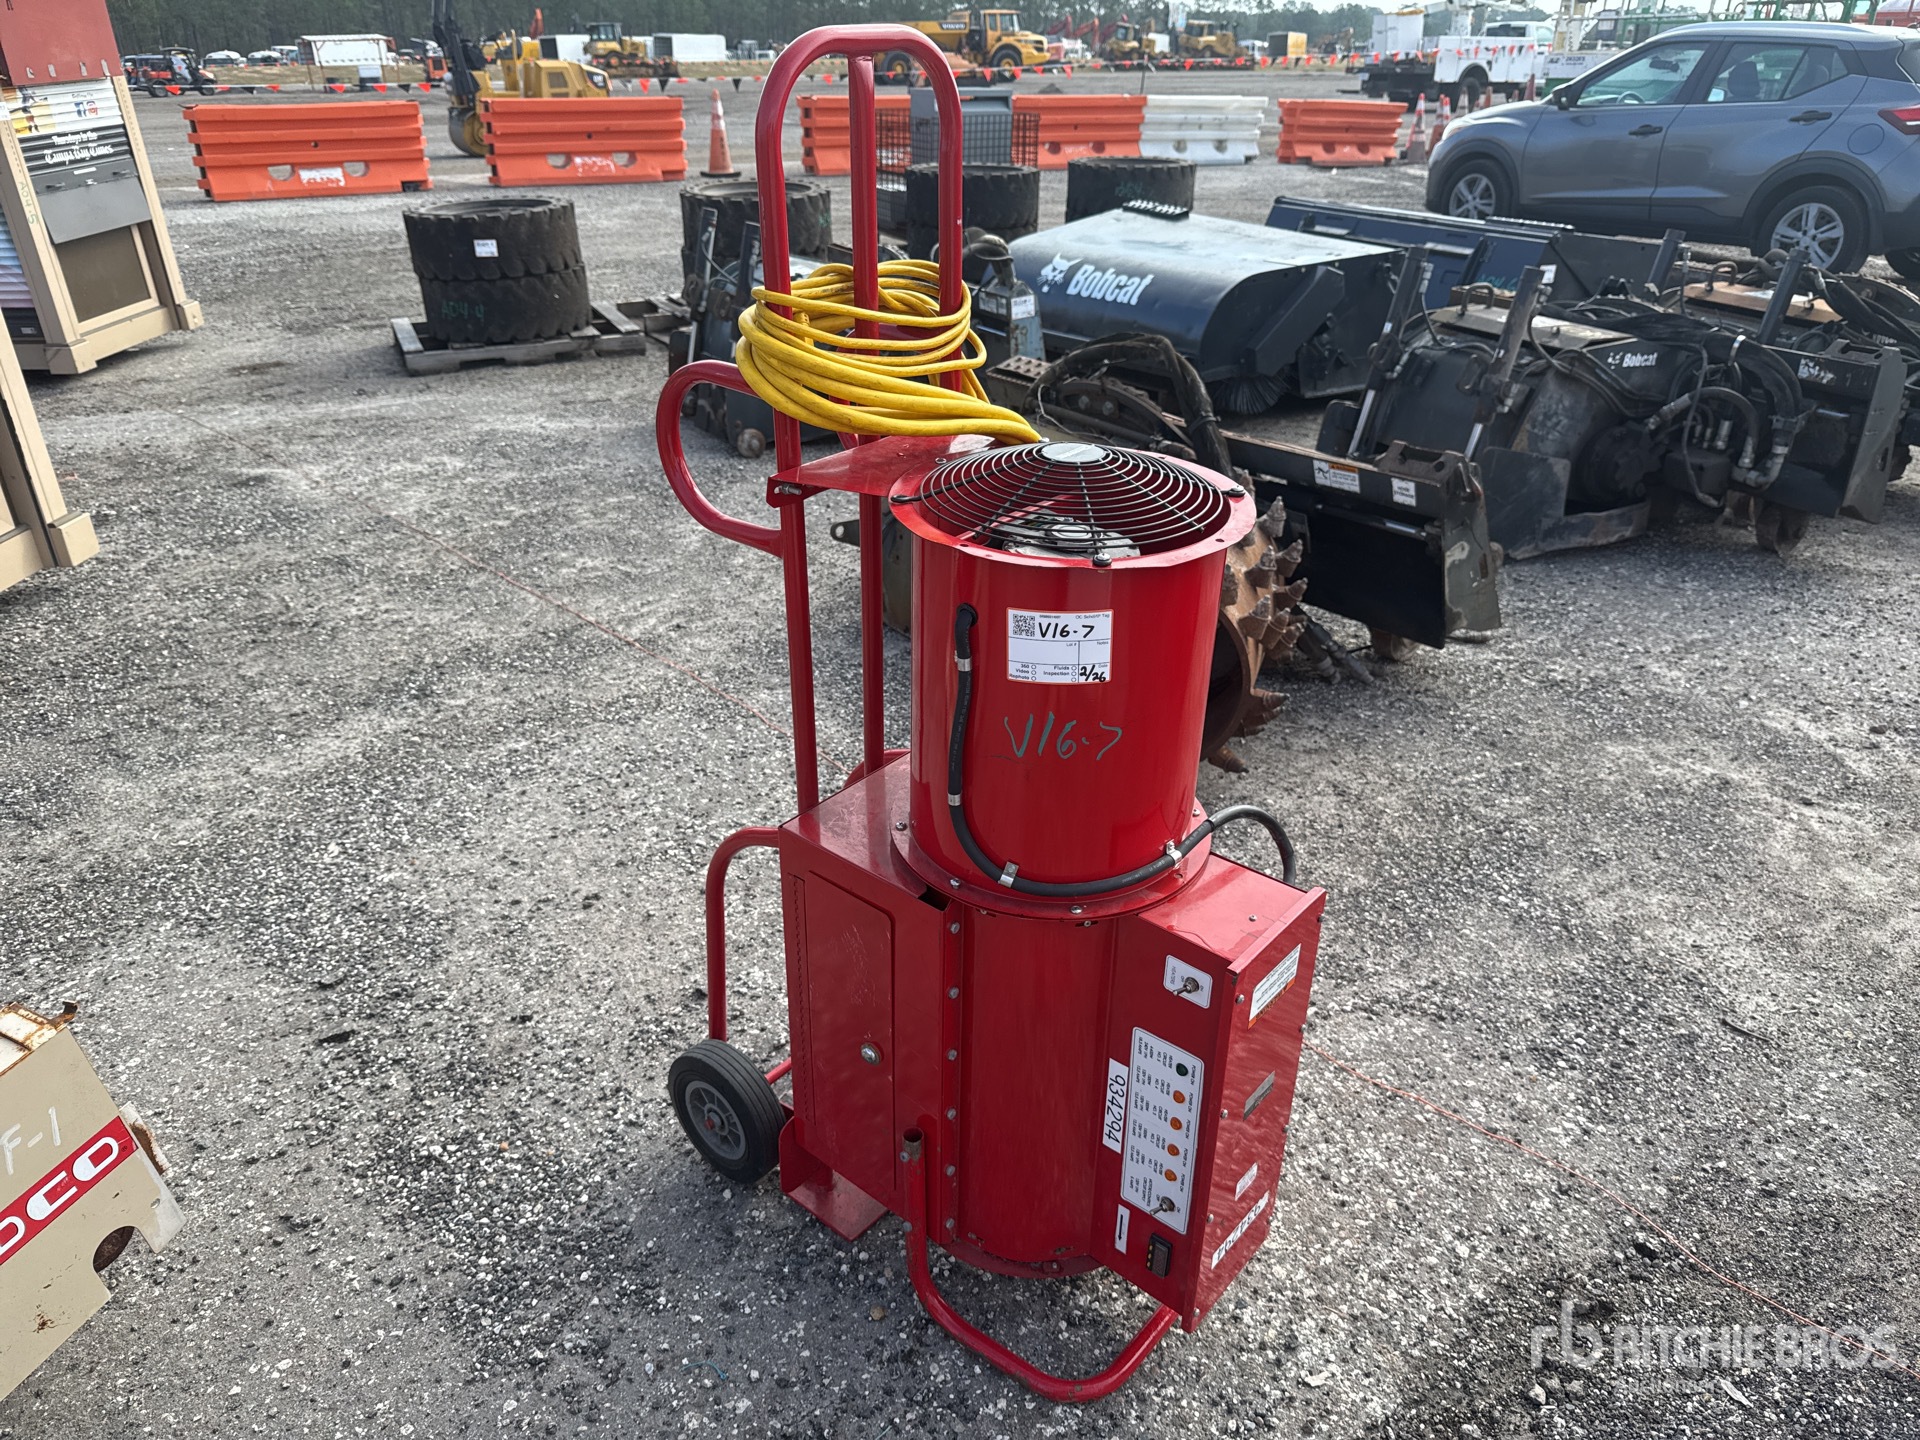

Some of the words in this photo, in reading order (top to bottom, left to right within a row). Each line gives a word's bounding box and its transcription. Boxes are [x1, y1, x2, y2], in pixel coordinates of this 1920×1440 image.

[1066, 264, 1154, 306] Bobcat
[1622, 352, 1658, 368] Bobcat
[1038, 621, 1095, 639] V16-7
[1079, 664, 1107, 683] 2/26
[1004, 711, 1123, 761] V16-7
[1105, 1074, 1126, 1144] 934294
